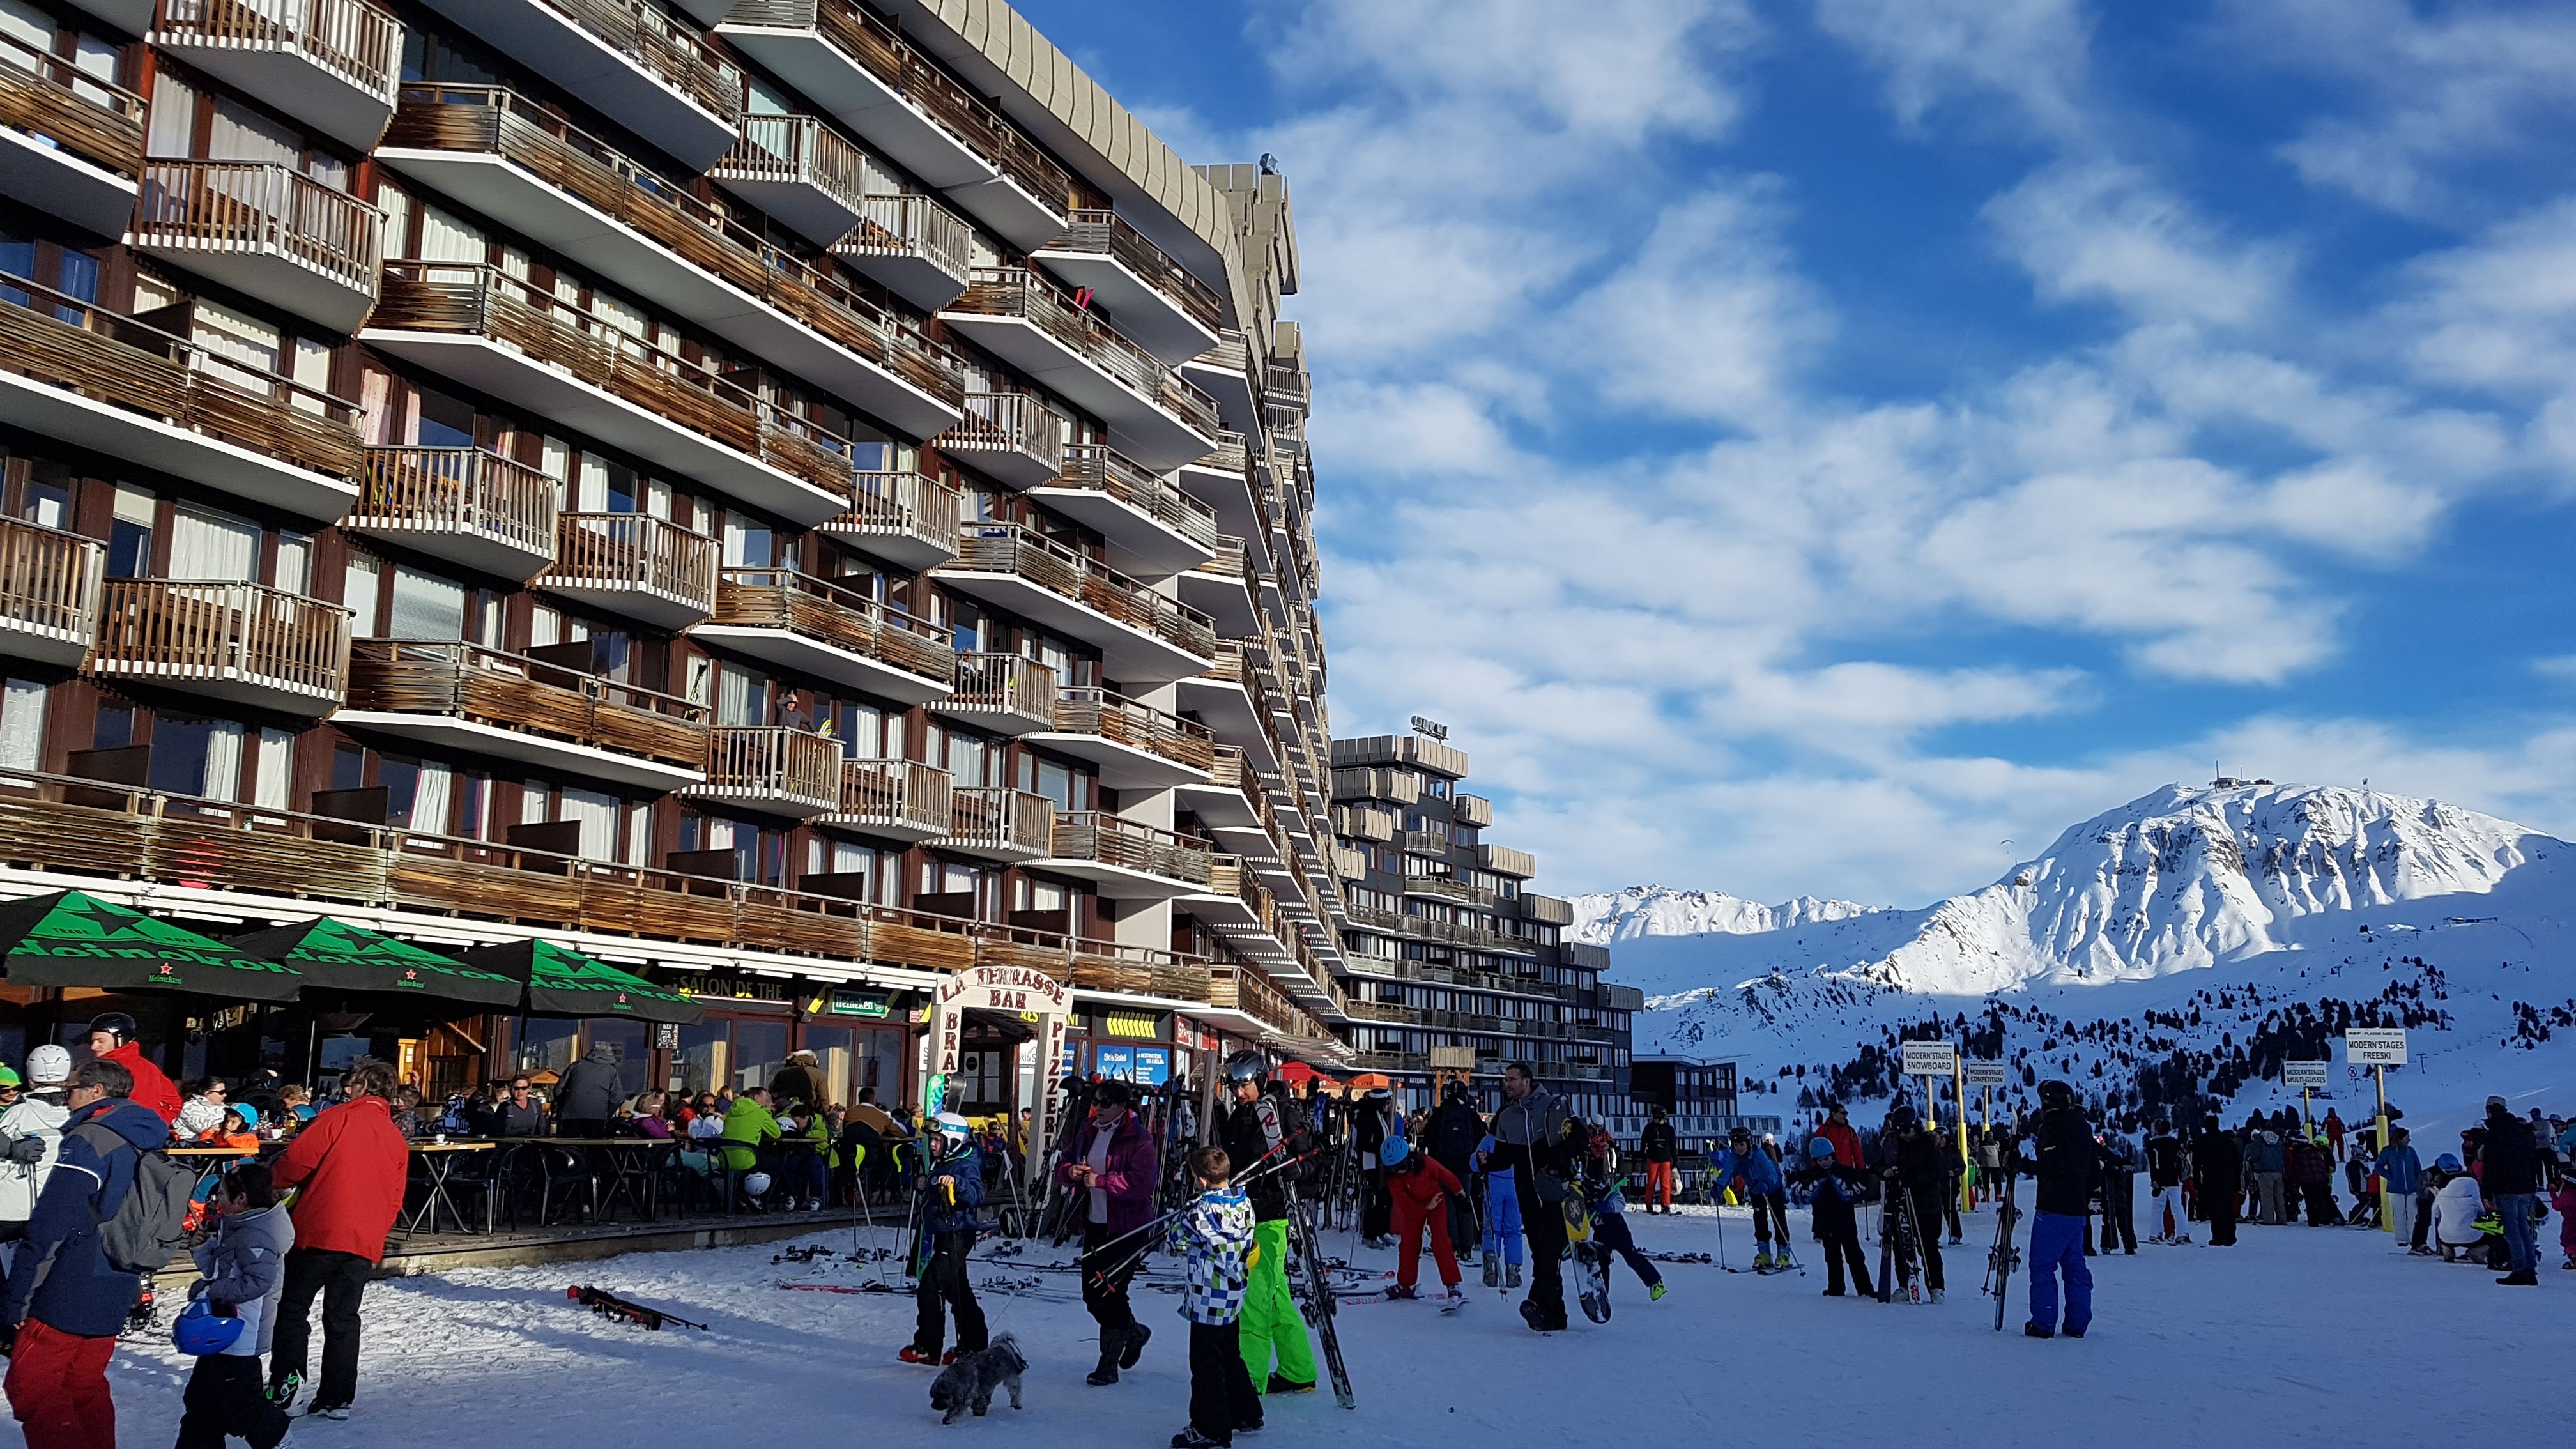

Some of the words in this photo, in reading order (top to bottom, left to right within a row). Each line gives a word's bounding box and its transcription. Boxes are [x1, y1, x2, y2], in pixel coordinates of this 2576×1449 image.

[148, 974, 183, 985] Heineken
[680, 976, 731, 997] SALON
[735, 981, 753, 998] DE
[758, 983, 783, 1000] THE
[940, 976, 968, 1002] LA
[976, 968, 1064, 1006] TERRASSE
[836, 996, 873, 1010] Heineken
[989, 989, 1027, 1009] BAR
[2349, 1041, 2404, 1049] MODERN'STAGES
[1907, 1061, 1951, 1070] SNOWBOARD
[1043, 1021, 1063, 1149] PIZZERI
